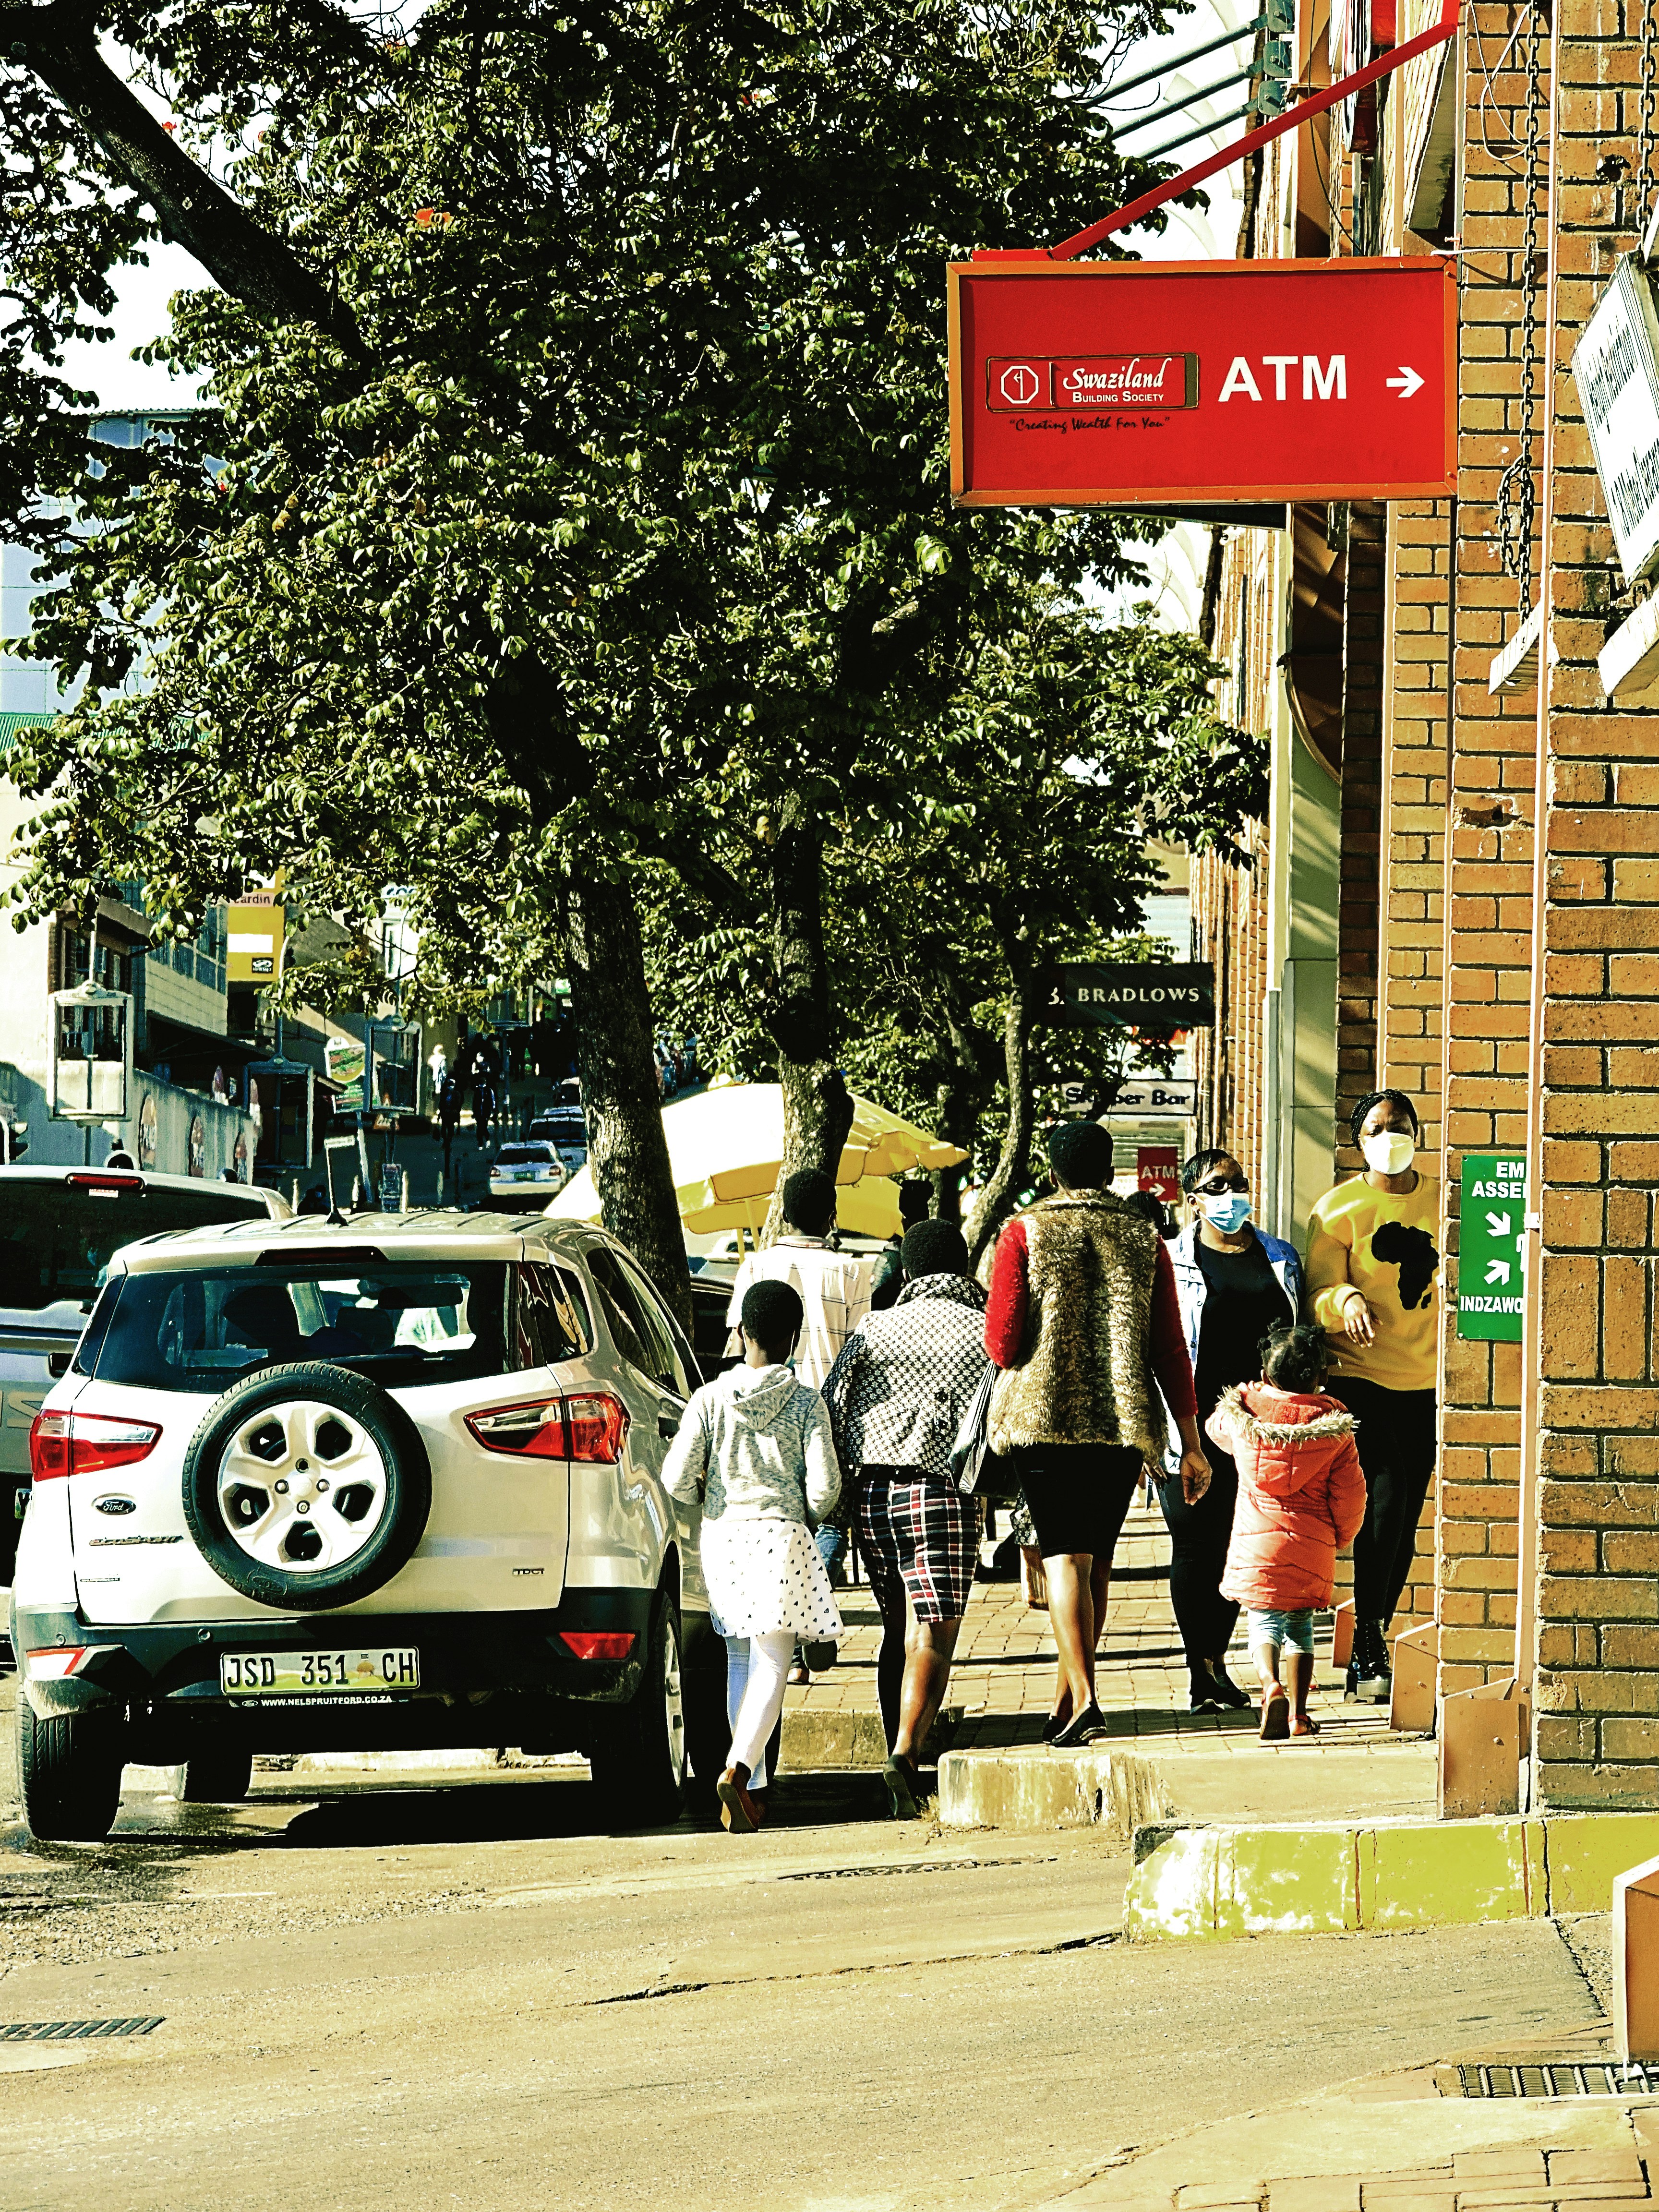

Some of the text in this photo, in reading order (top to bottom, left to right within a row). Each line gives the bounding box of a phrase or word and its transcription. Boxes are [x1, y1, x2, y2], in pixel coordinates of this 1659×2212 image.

[1063, 357, 1172, 390] Swaziland
[1218, 354, 1347, 402] ATM
[1071, 416, 1112, 431] Wealth
[1116, 416, 1138, 429] For
[1078, 987, 1200, 1002] BRADLOWS
[1065, 1087, 1190, 1106] Sper Bar
[1142, 1166, 1175, 1179] ATM
[1471, 1180, 1527, 1199] ASSE
[227, 1652, 415, 1688] JSD 351 CH
[261, 1695, 393, 1707] WWW.NELSPRUITFORD.CO.ZA
